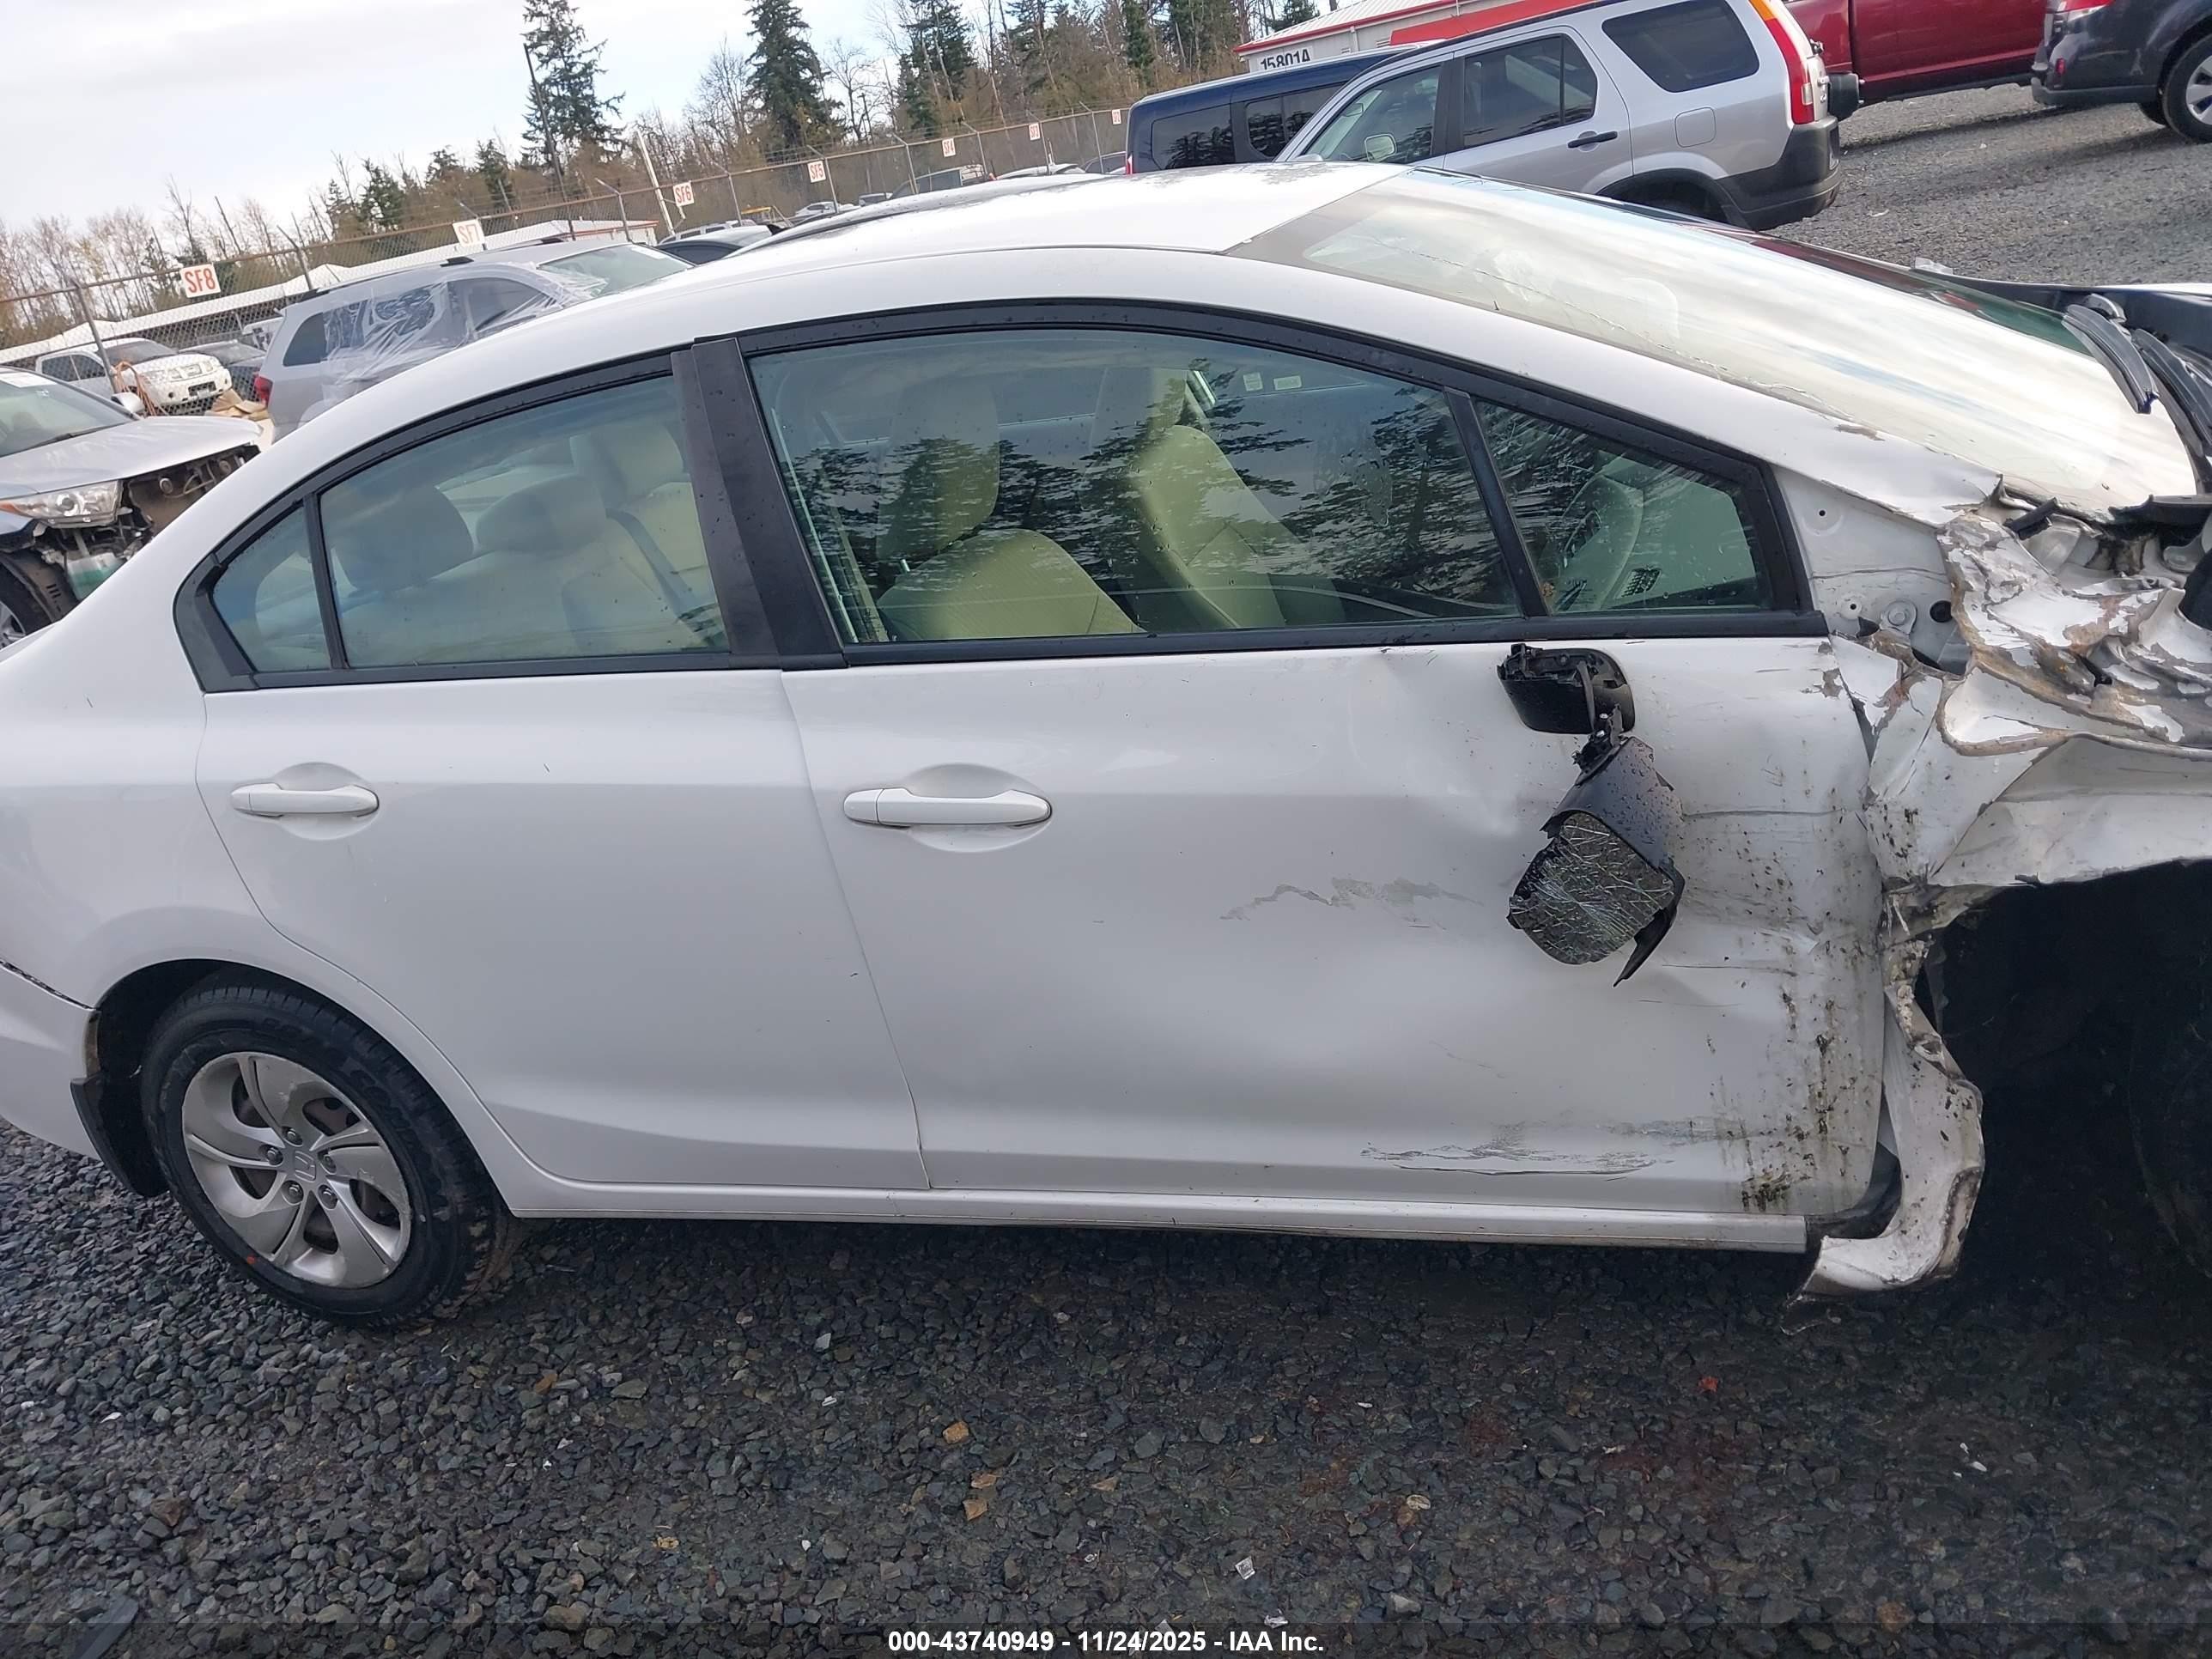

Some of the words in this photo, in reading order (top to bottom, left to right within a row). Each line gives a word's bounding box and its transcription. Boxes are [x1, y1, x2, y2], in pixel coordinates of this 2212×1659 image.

[1261, 49, 1310, 70] 15801A
[810, 163, 823, 179] SF5
[675, 185, 692, 204] SF6
[458, 223, 481, 244] SF7
[185, 268, 216, 293] SF8
